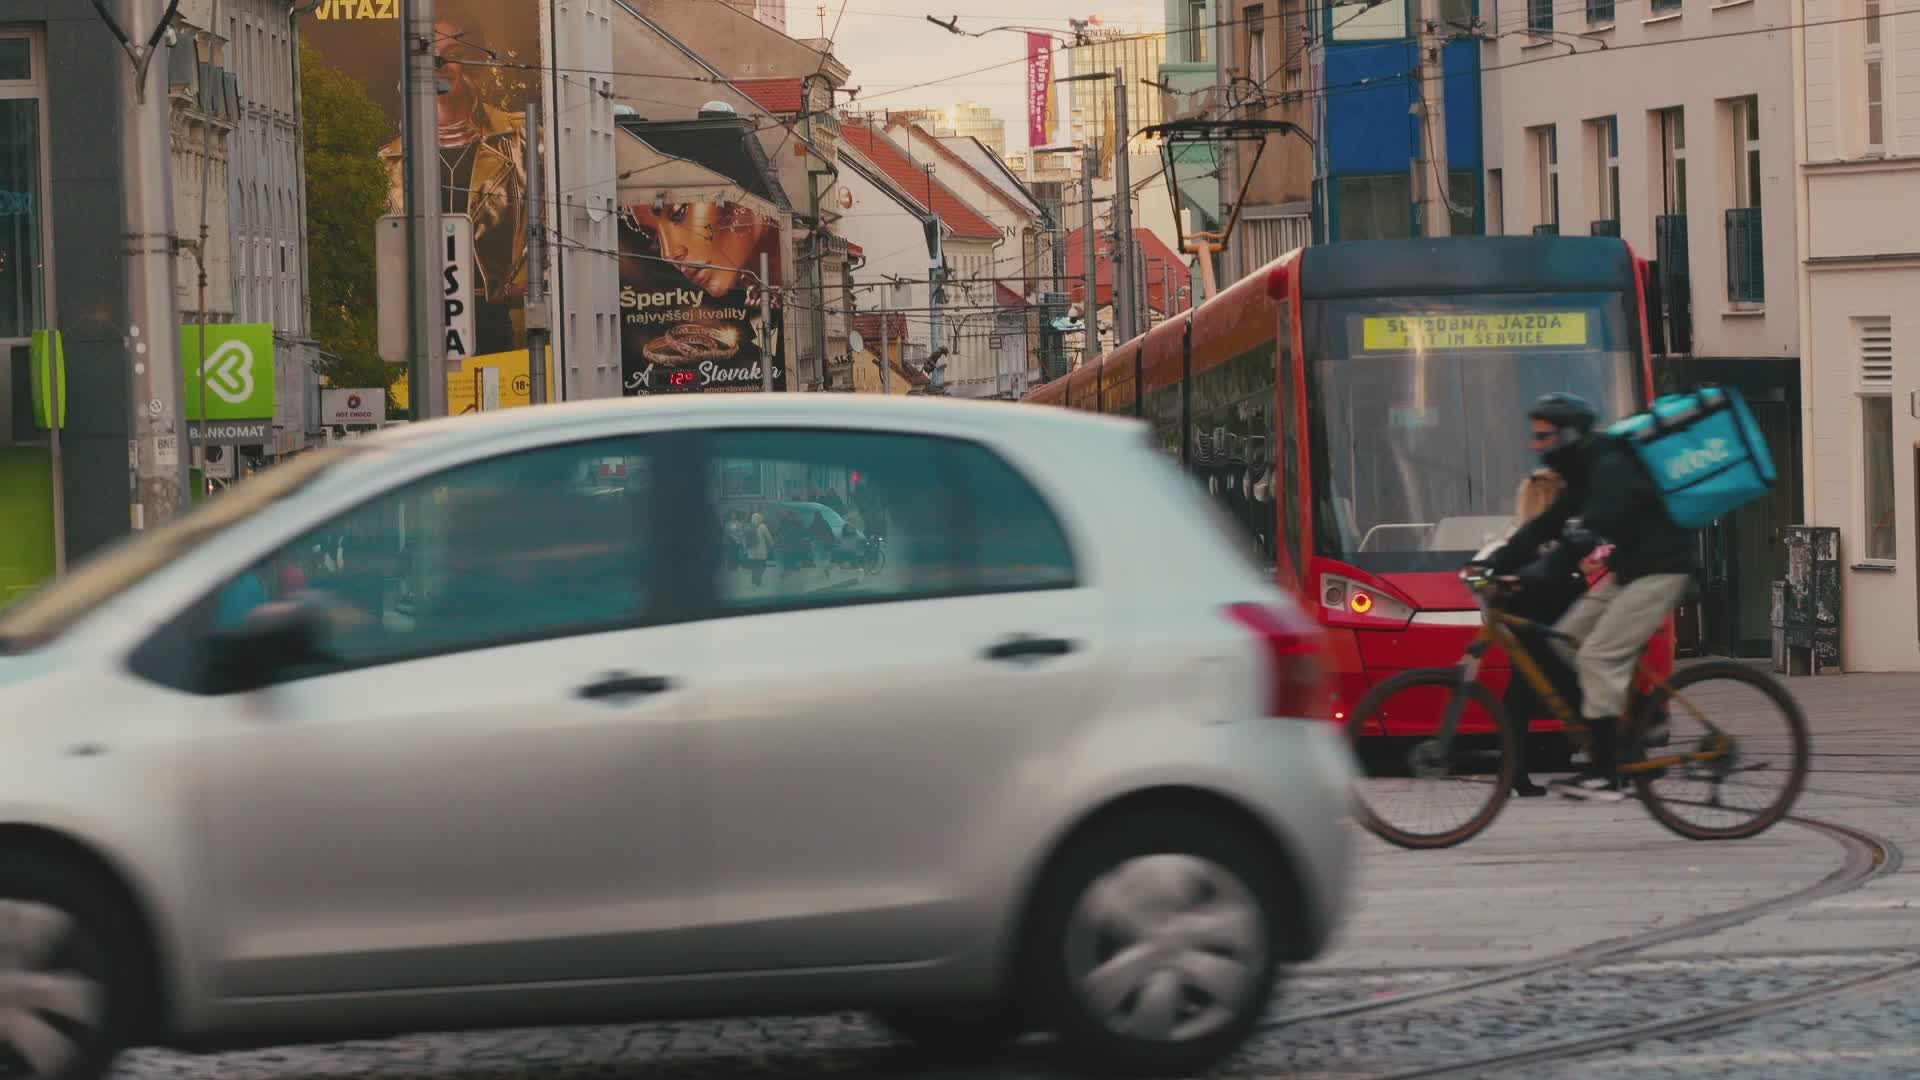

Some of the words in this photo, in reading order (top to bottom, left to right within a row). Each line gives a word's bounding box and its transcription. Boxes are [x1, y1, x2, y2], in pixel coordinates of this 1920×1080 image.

[620, 286, 704, 310] Šperky
[627, 310, 695, 324] najvyššej
[700, 308, 747, 321] kvality
[1500, 315, 1562, 330] JAZDA
[1474, 331, 1545, 344] SERVICE
[699, 360, 782, 386] Slovaka
[189, 426, 264, 439] BNKOMAT
